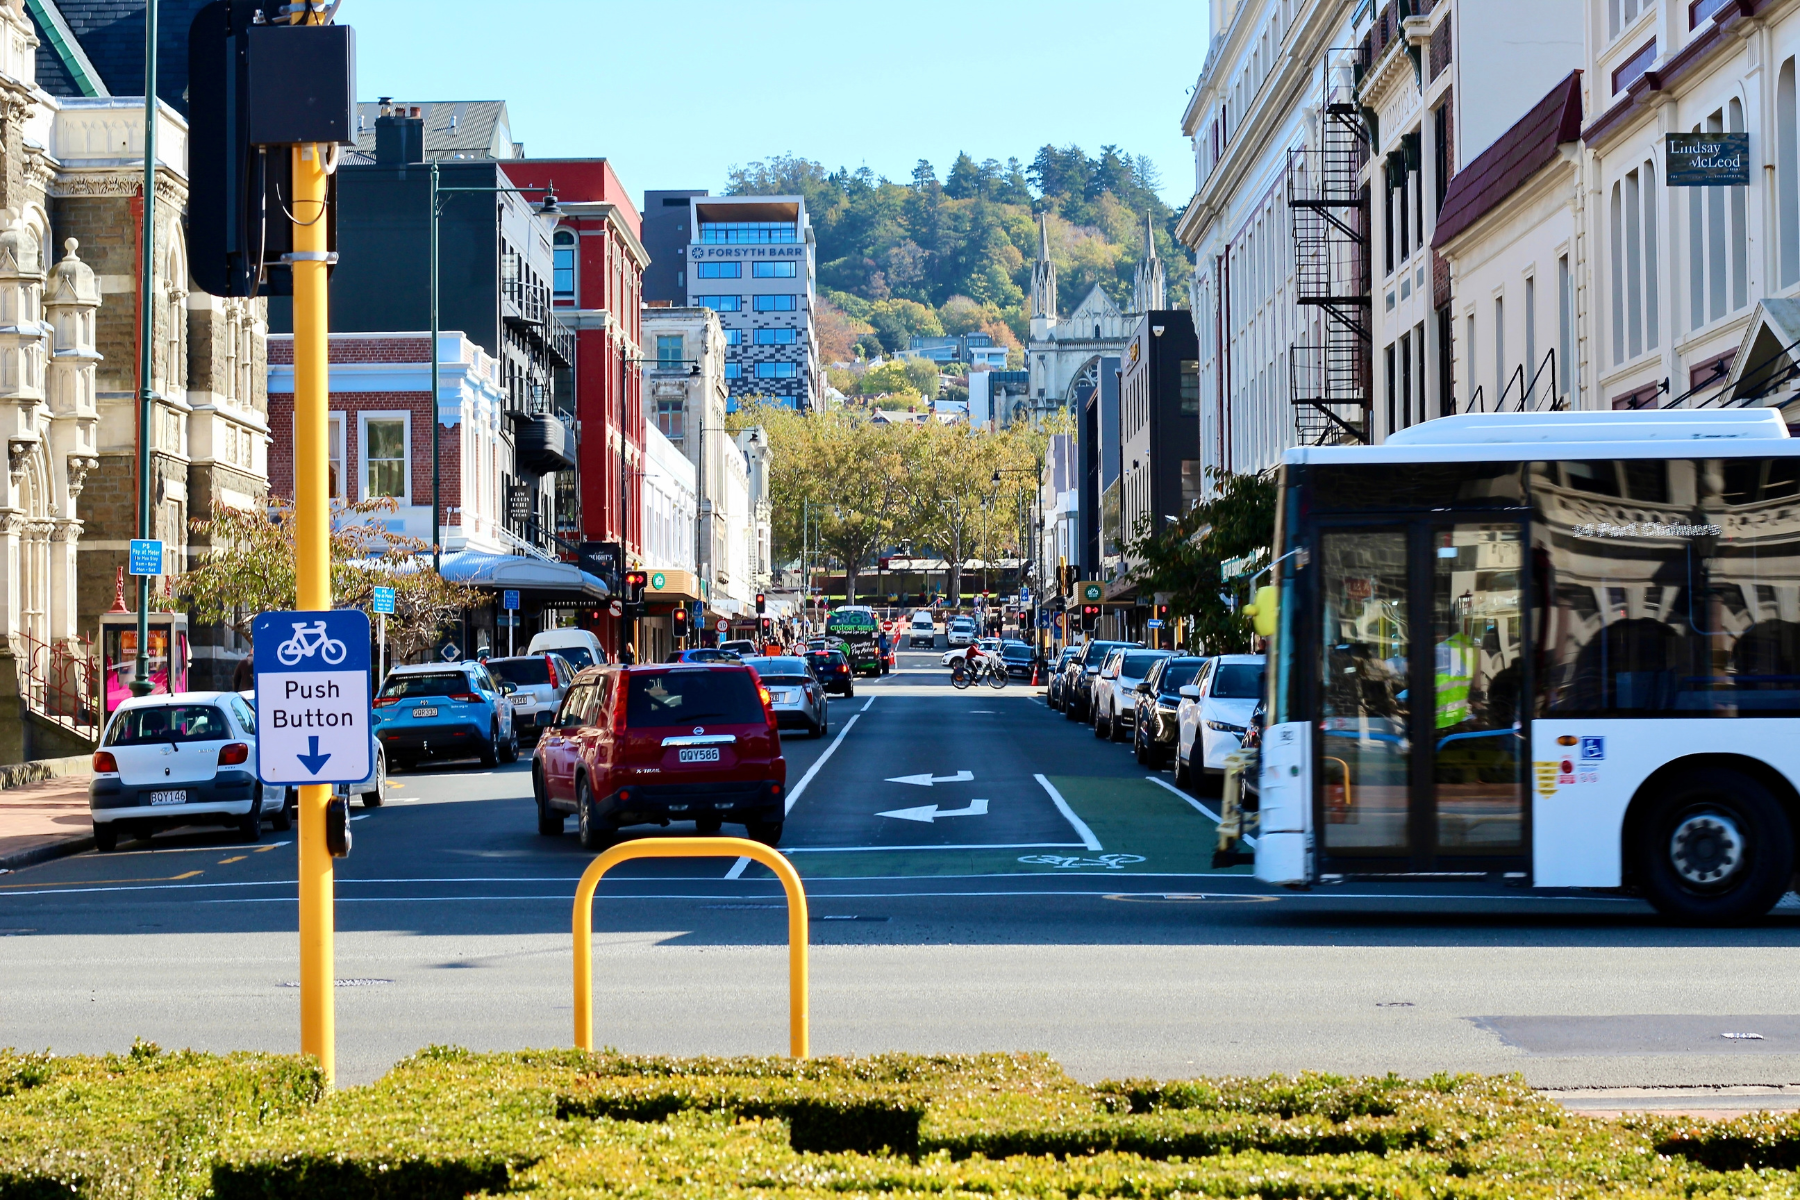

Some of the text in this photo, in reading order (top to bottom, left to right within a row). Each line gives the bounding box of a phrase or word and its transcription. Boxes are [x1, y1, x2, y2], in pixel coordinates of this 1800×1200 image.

[1670, 141, 1721, 157] Lindsay
[1689, 153, 1740, 168] McLeod
[708, 247, 802, 257] FORSYTH BARR
[1596, 521, 1638, 537] Port
[285, 680, 340, 699] Push
[273, 708, 353, 728] Button
[680, 749, 718, 760] QQY586
